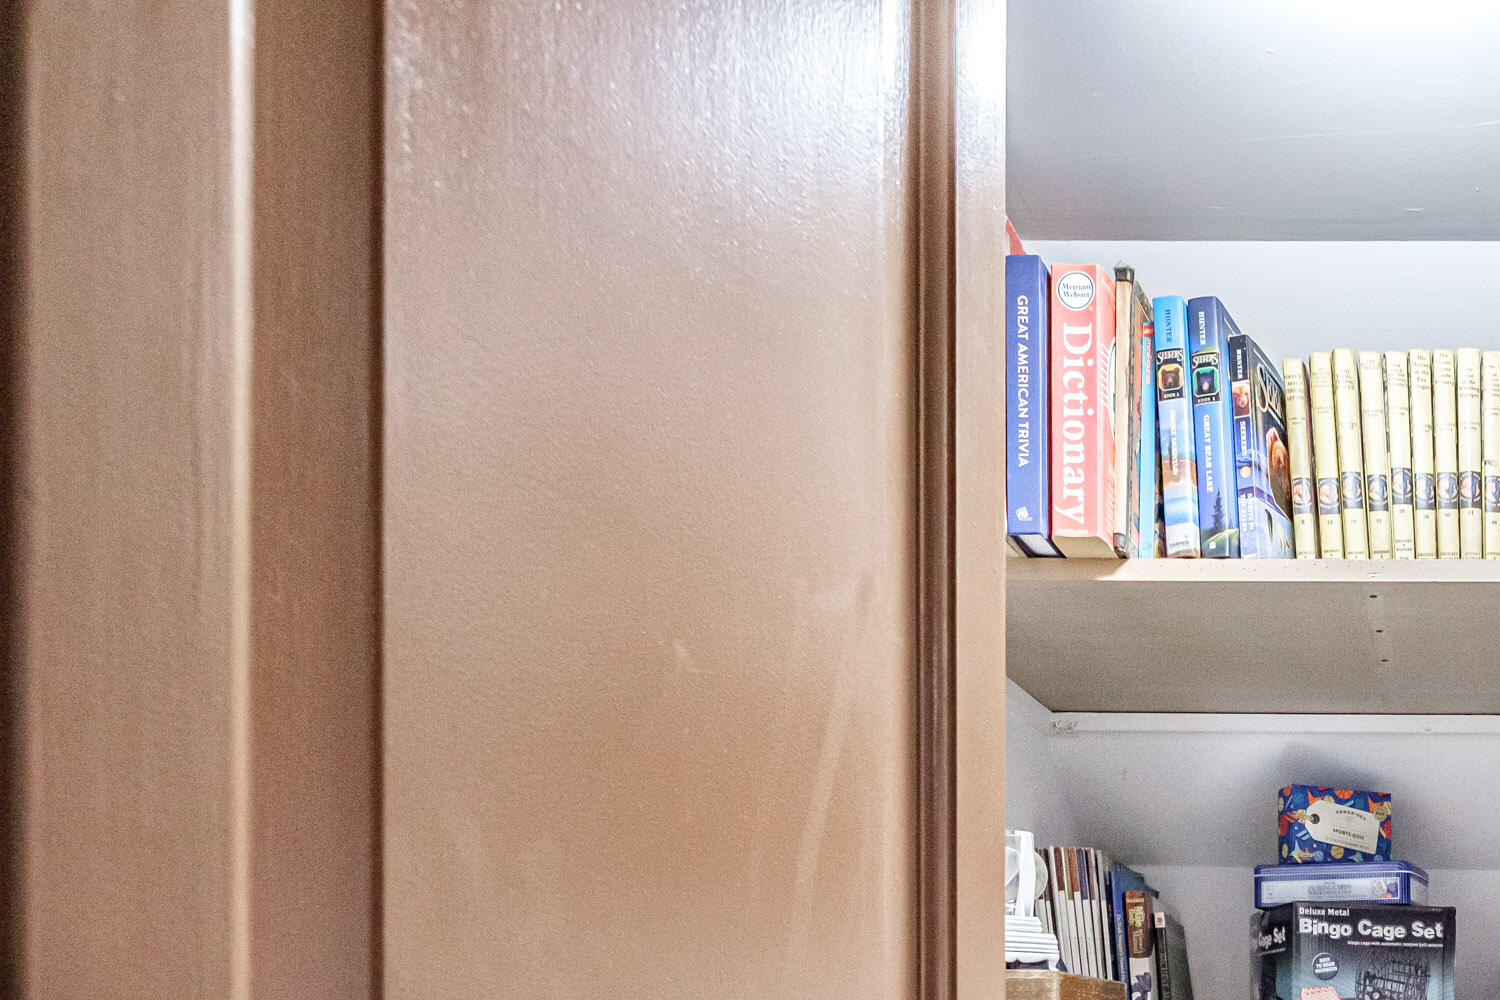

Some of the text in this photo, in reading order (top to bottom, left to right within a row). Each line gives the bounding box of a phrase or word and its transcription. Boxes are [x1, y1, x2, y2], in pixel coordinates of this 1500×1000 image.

[1164, 309, 1173, 343] HUNTER
[1198, 311, 1207, 345] HUNTER
[1017, 295, 1030, 467] GREAT AMERICAN TRIVIA
[1054, 322, 1094, 524] Dictionary
[1203, 414, 1214, 493] GREAT BEAR LAKE
[1299, 907, 1350, 916] Deluxe Metal
[1273, 926, 1286, 944] Set
[1299, 918, 1444, 940] Bingo Cage Set
